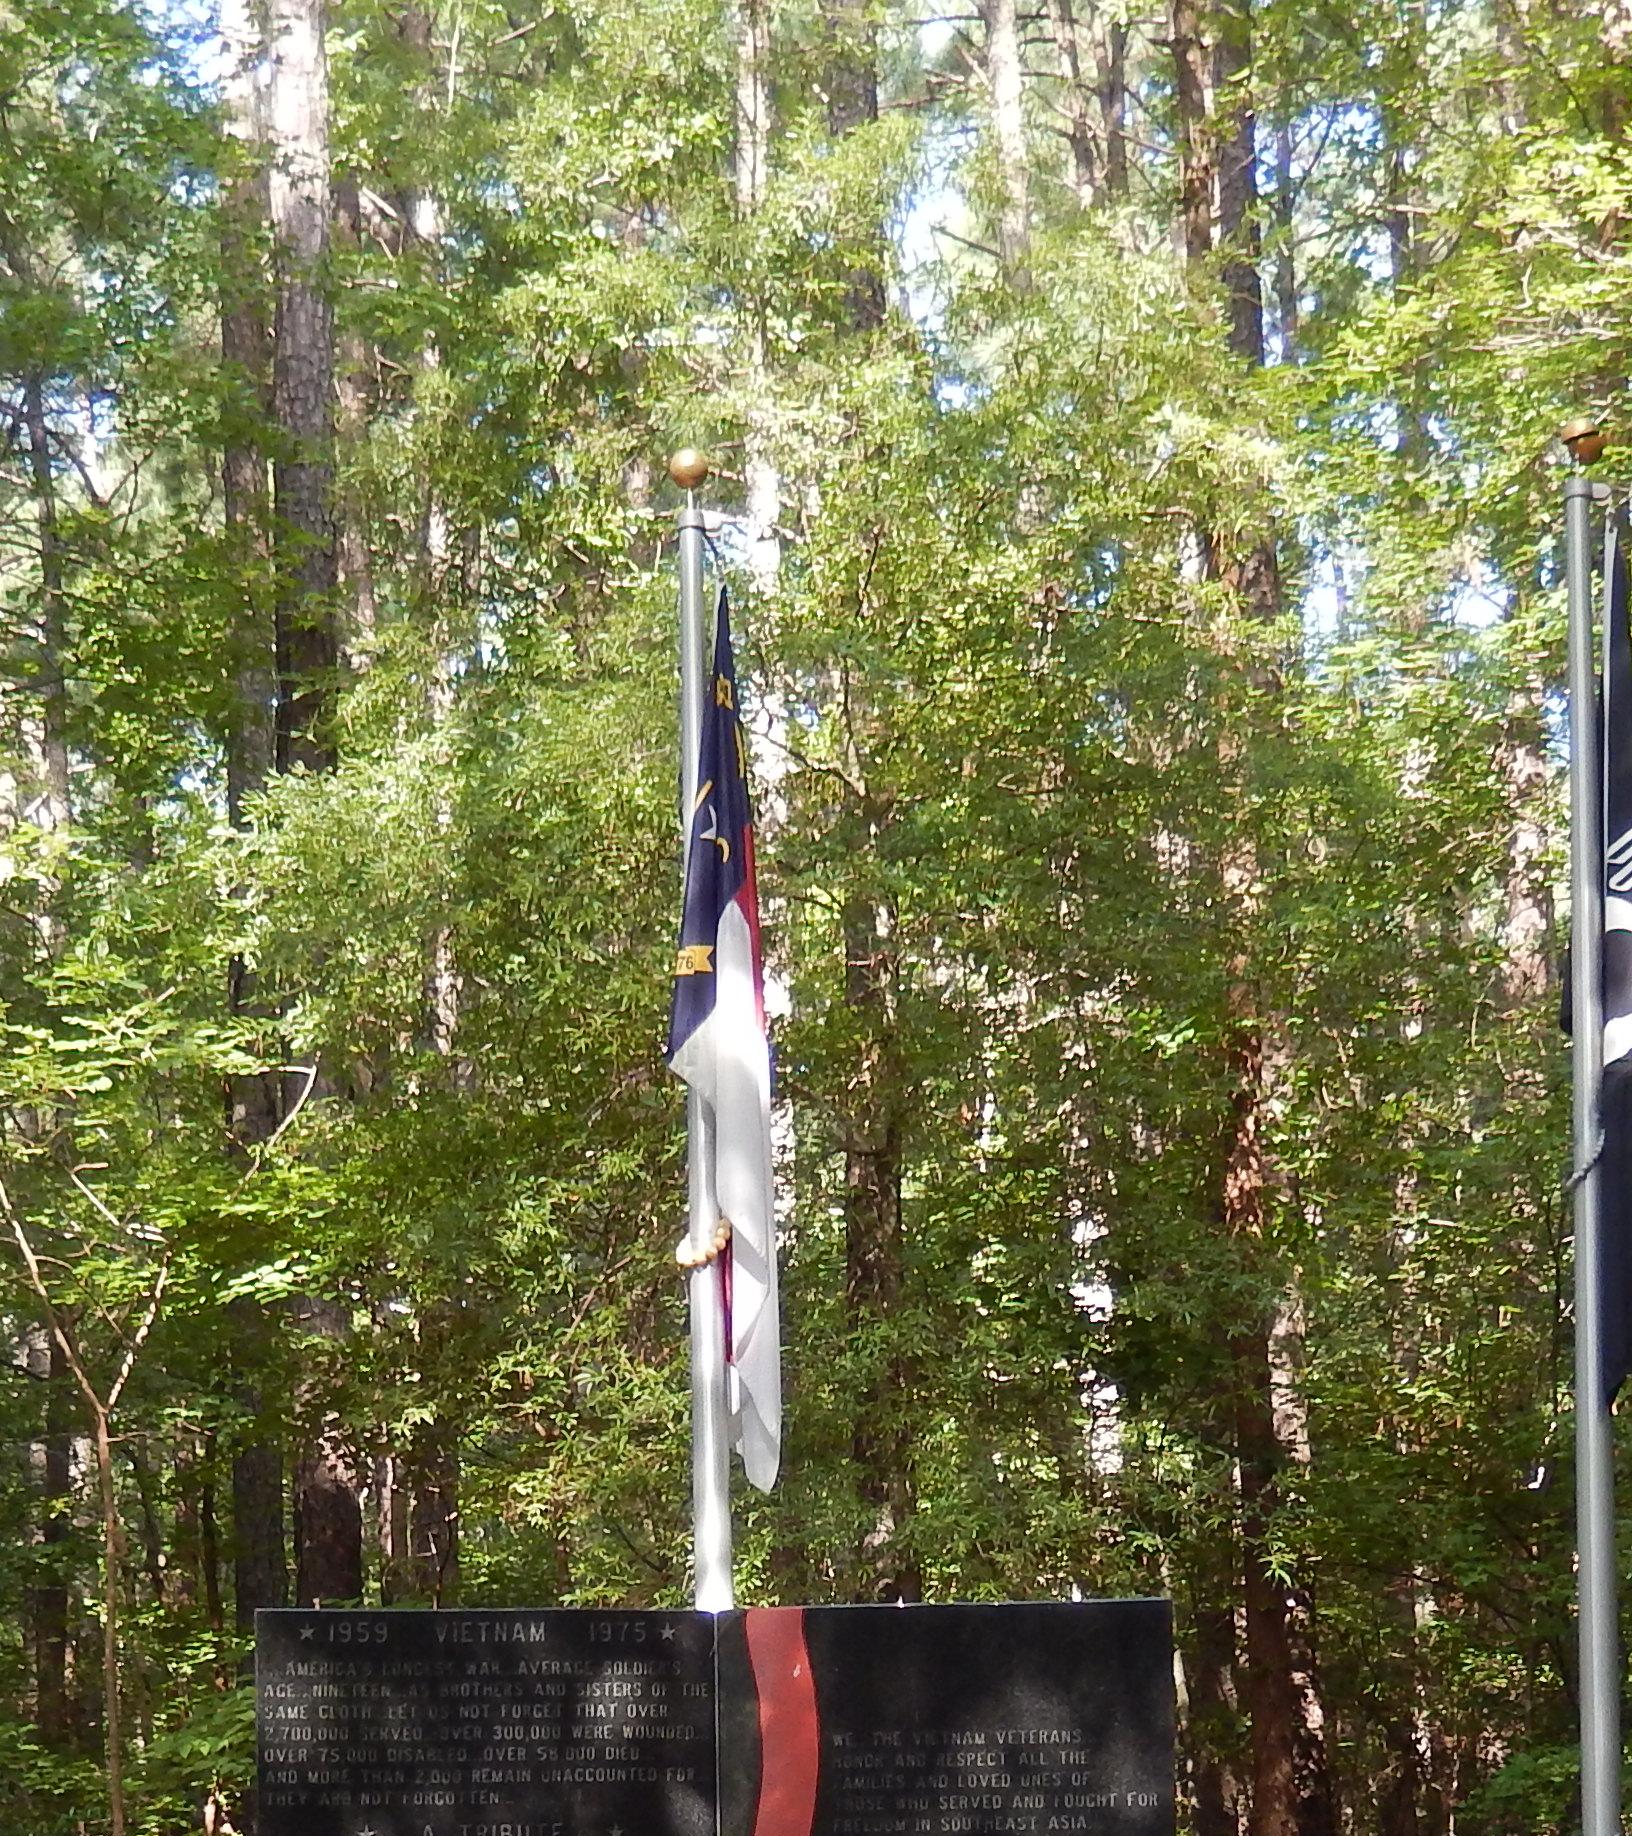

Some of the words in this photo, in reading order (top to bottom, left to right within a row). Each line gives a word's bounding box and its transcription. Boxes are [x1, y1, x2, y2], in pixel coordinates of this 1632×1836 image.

[329, 1622, 388, 1643] 1959
[436, 1622, 546, 1643] VIETNAM
[589, 1622, 646, 1643] 1975
[576, 1703, 618, 1718] THAT
[627, 1704, 668, 1718] OVER
[493, 1725, 561, 1742] 300,000
[572, 1725, 613, 1740] WERE
[264, 1748, 307, 1762] OVER
[937, 1751, 1005, 1767] RESPECT
[1019, 1752, 1048, 1766] ALL
[1060, 1750, 1088, 1765] THE
[266, 1770, 297, 1784] AND
[472, 1768, 531, 1783] REMAIN
[541, 1767, 657, 1783] UNACCOUNTED
[958, 1773, 1010, 1788] LOVED
[1021, 1772, 1061, 1787] ONES
[1072, 1772, 1090, 1786] OF
[939, 1795, 1001, 1810] SERVED
[1013, 1795, 1044, 1809] AND
[1127, 1792, 1157, 1807] FOR
[916, 1818, 930, 1832] IN
